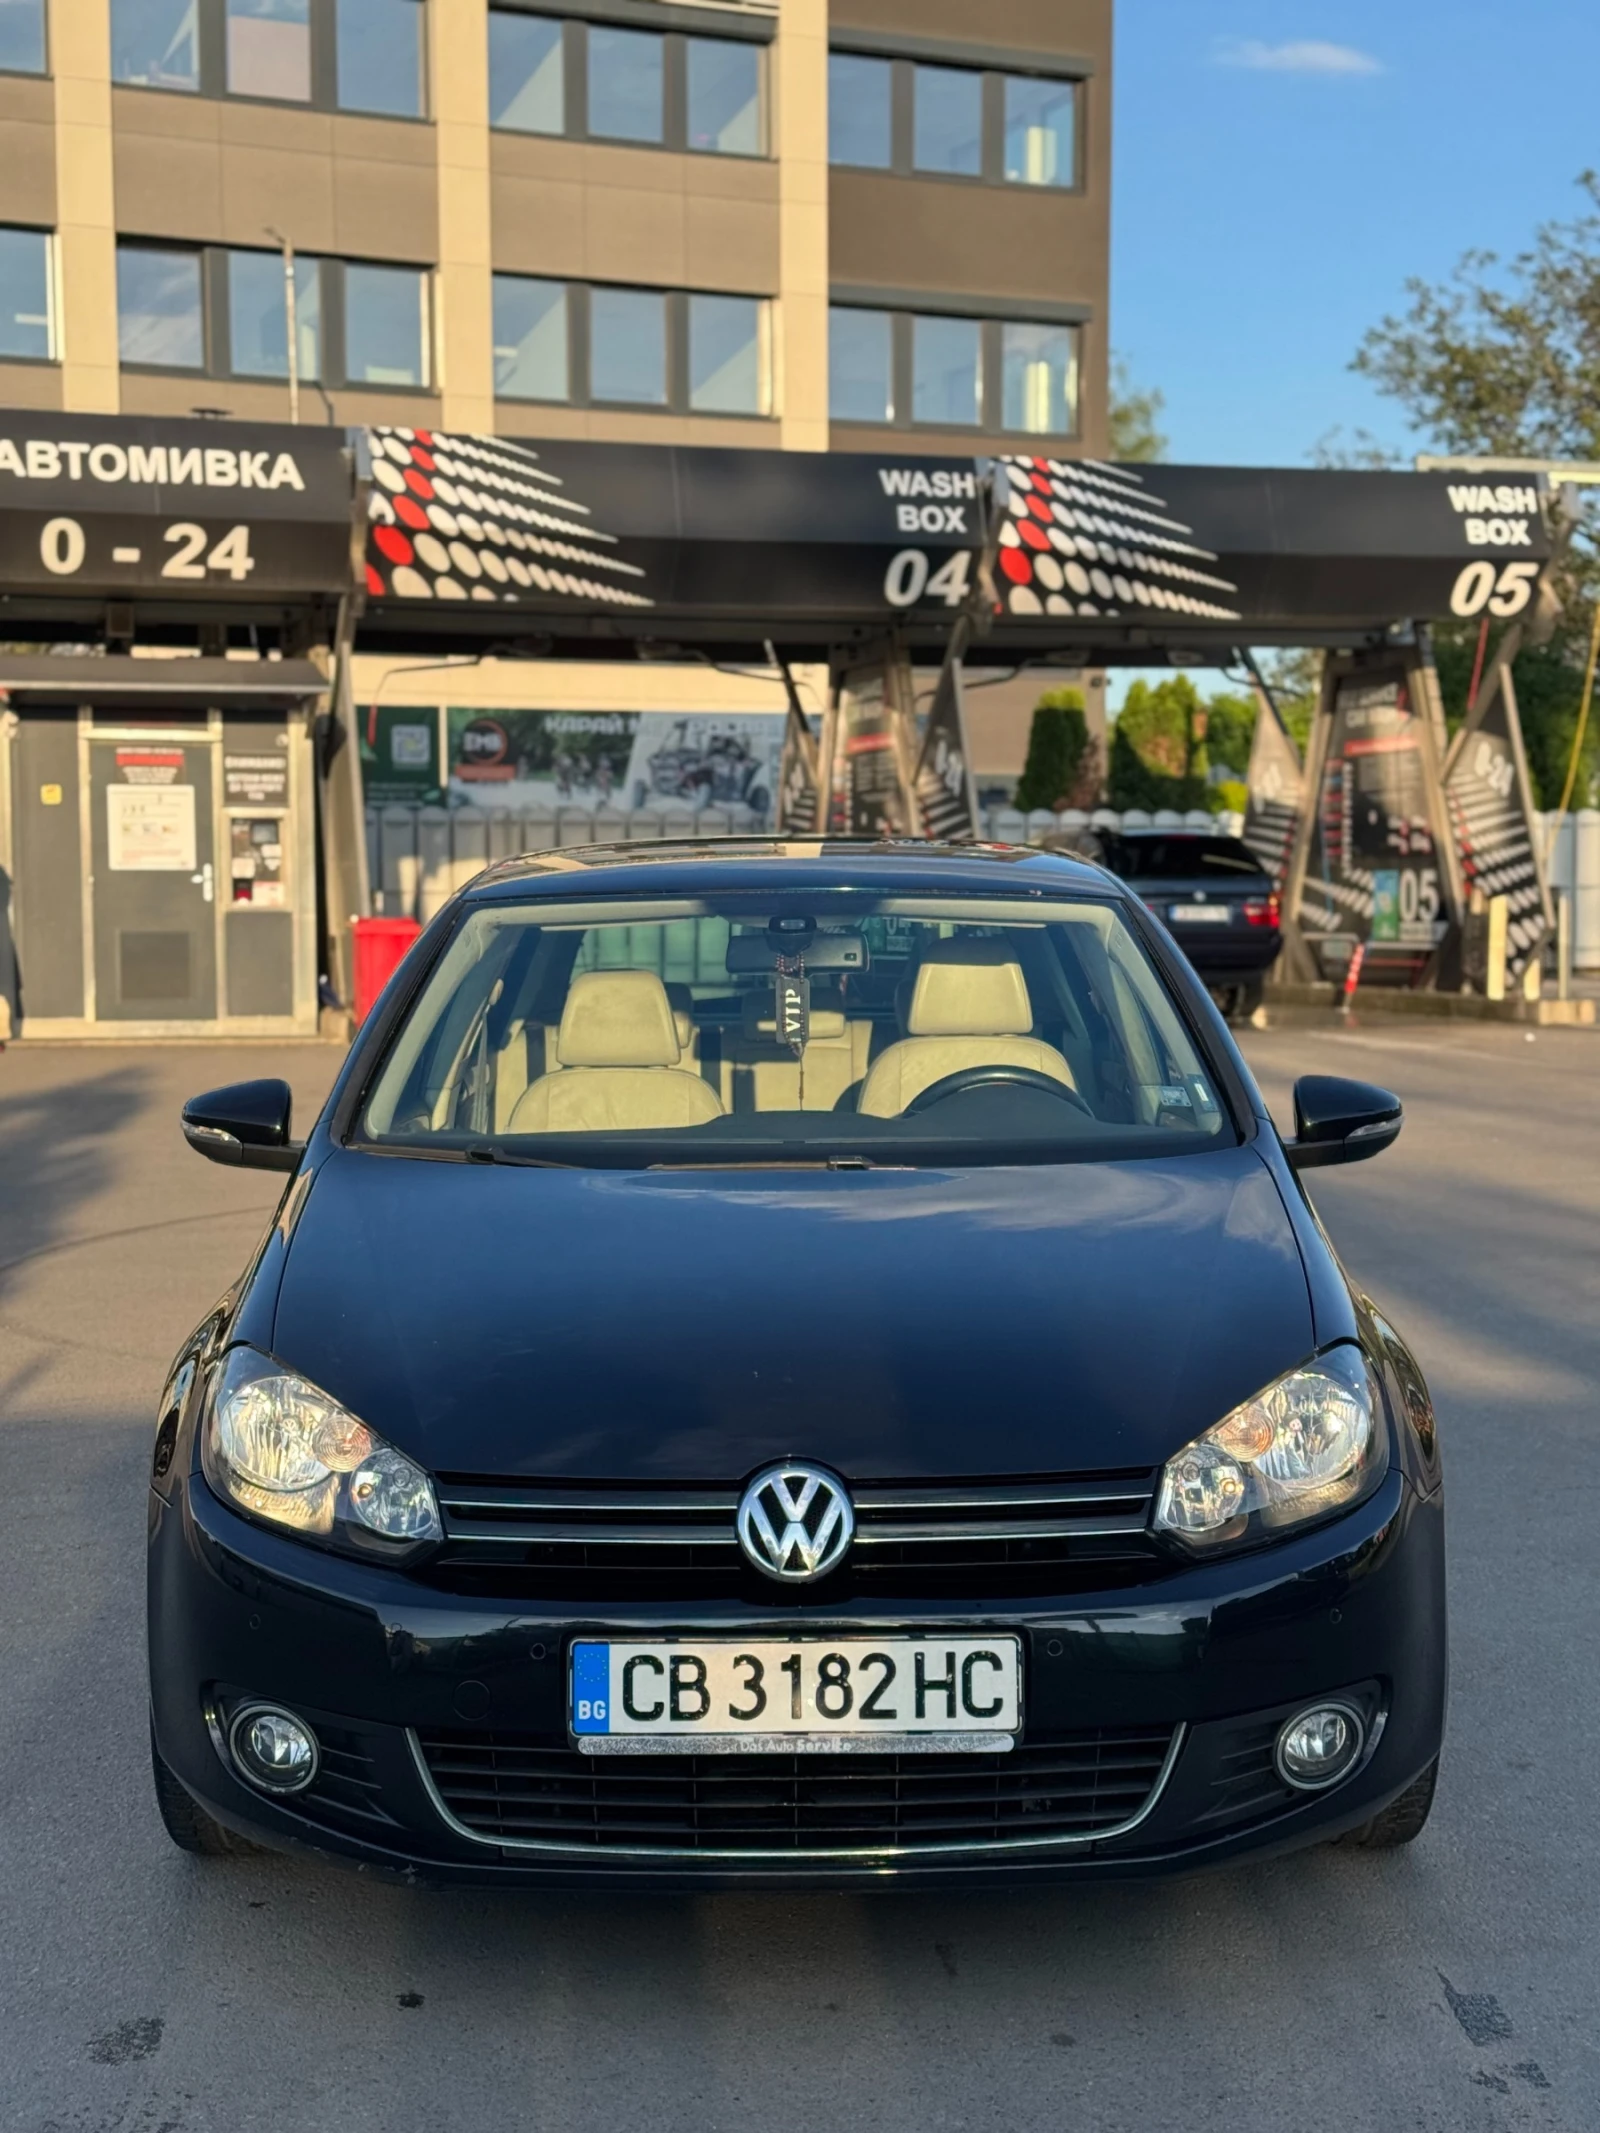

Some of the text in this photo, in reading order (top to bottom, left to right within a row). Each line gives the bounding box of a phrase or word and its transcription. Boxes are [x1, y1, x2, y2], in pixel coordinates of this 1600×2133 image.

[0, 438, 305, 491] АВТОМИВКА
[878, 468, 976, 499] WASH
[896, 503, 968, 534] BOX
[1446, 485, 1538, 514] WASH
[40, 517, 86, 575] 0
[161, 522, 255, 580] 24
[1464, 517, 1532, 546] BOX
[884, 548, 972, 607] 04
[1450, 560, 1540, 617] 05
[1400, 868, 1440, 921] 05
[785, 988, 801, 1033] VIP
[577, 1699, 606, 1720] BG
[728, 1652, 898, 1722] 3182
